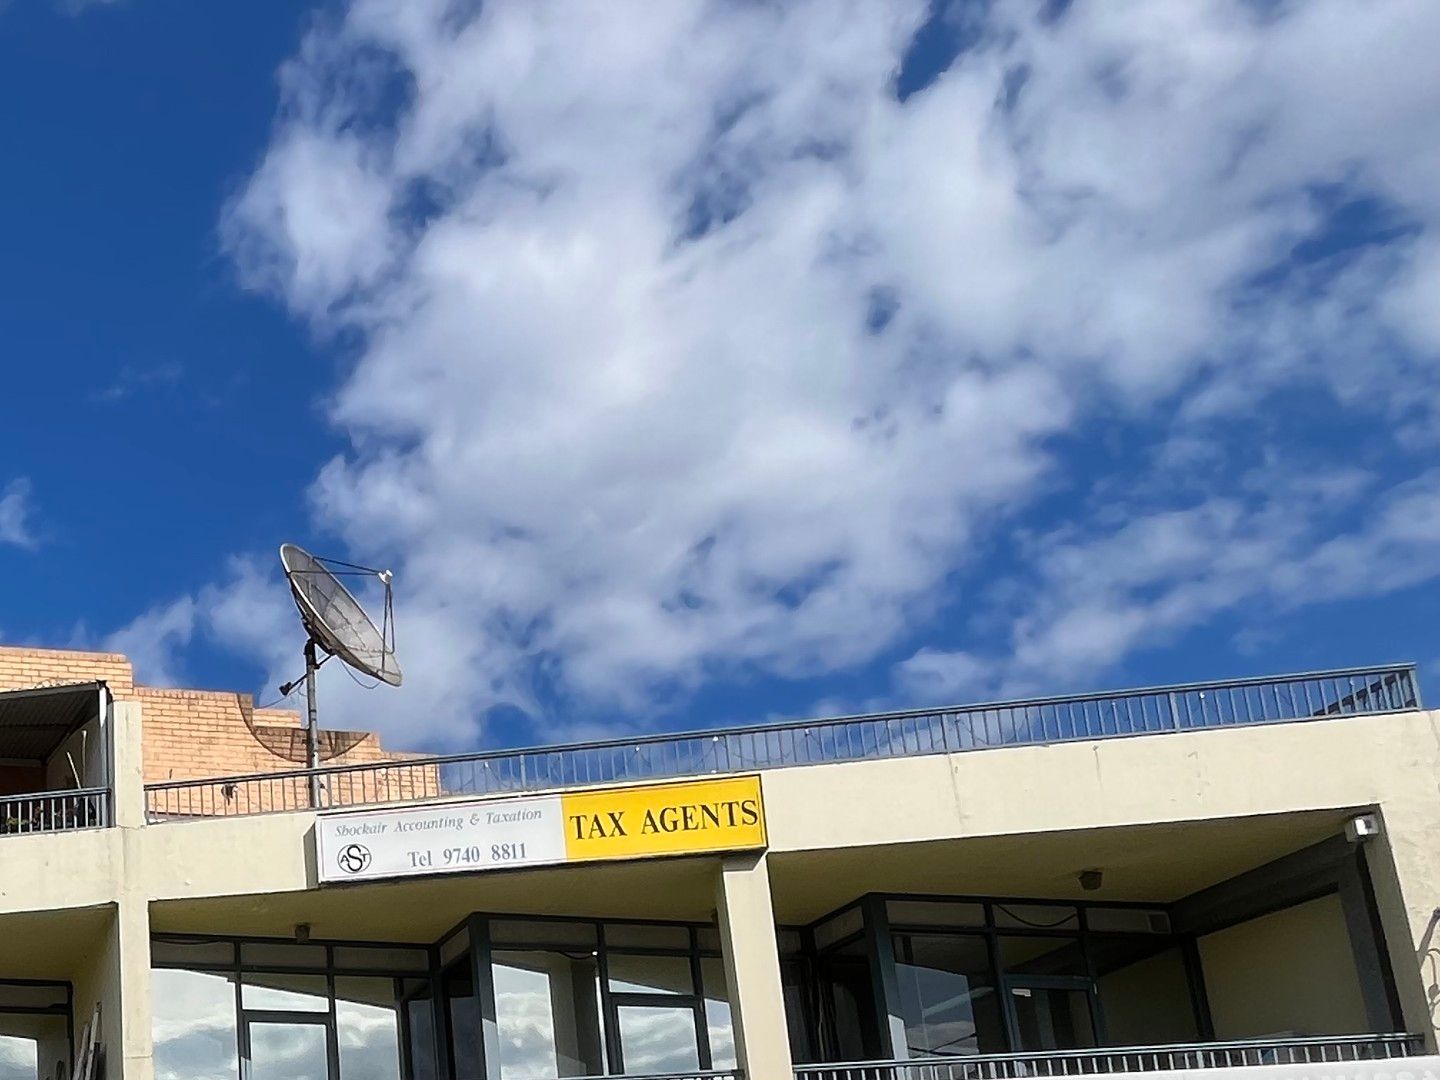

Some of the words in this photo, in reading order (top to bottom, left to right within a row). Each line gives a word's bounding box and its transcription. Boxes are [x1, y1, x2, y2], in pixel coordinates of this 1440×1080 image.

[394, 814, 464, 834] Accounting
[469, 813, 480, 826] &
[486, 808, 542, 827] Taxation
[569, 810, 626, 841] TAX
[641, 800, 759, 834] AGENTS
[408, 849, 432, 868] Tel
[443, 845, 481, 865] 9740
[492, 842, 527, 861] 8811
